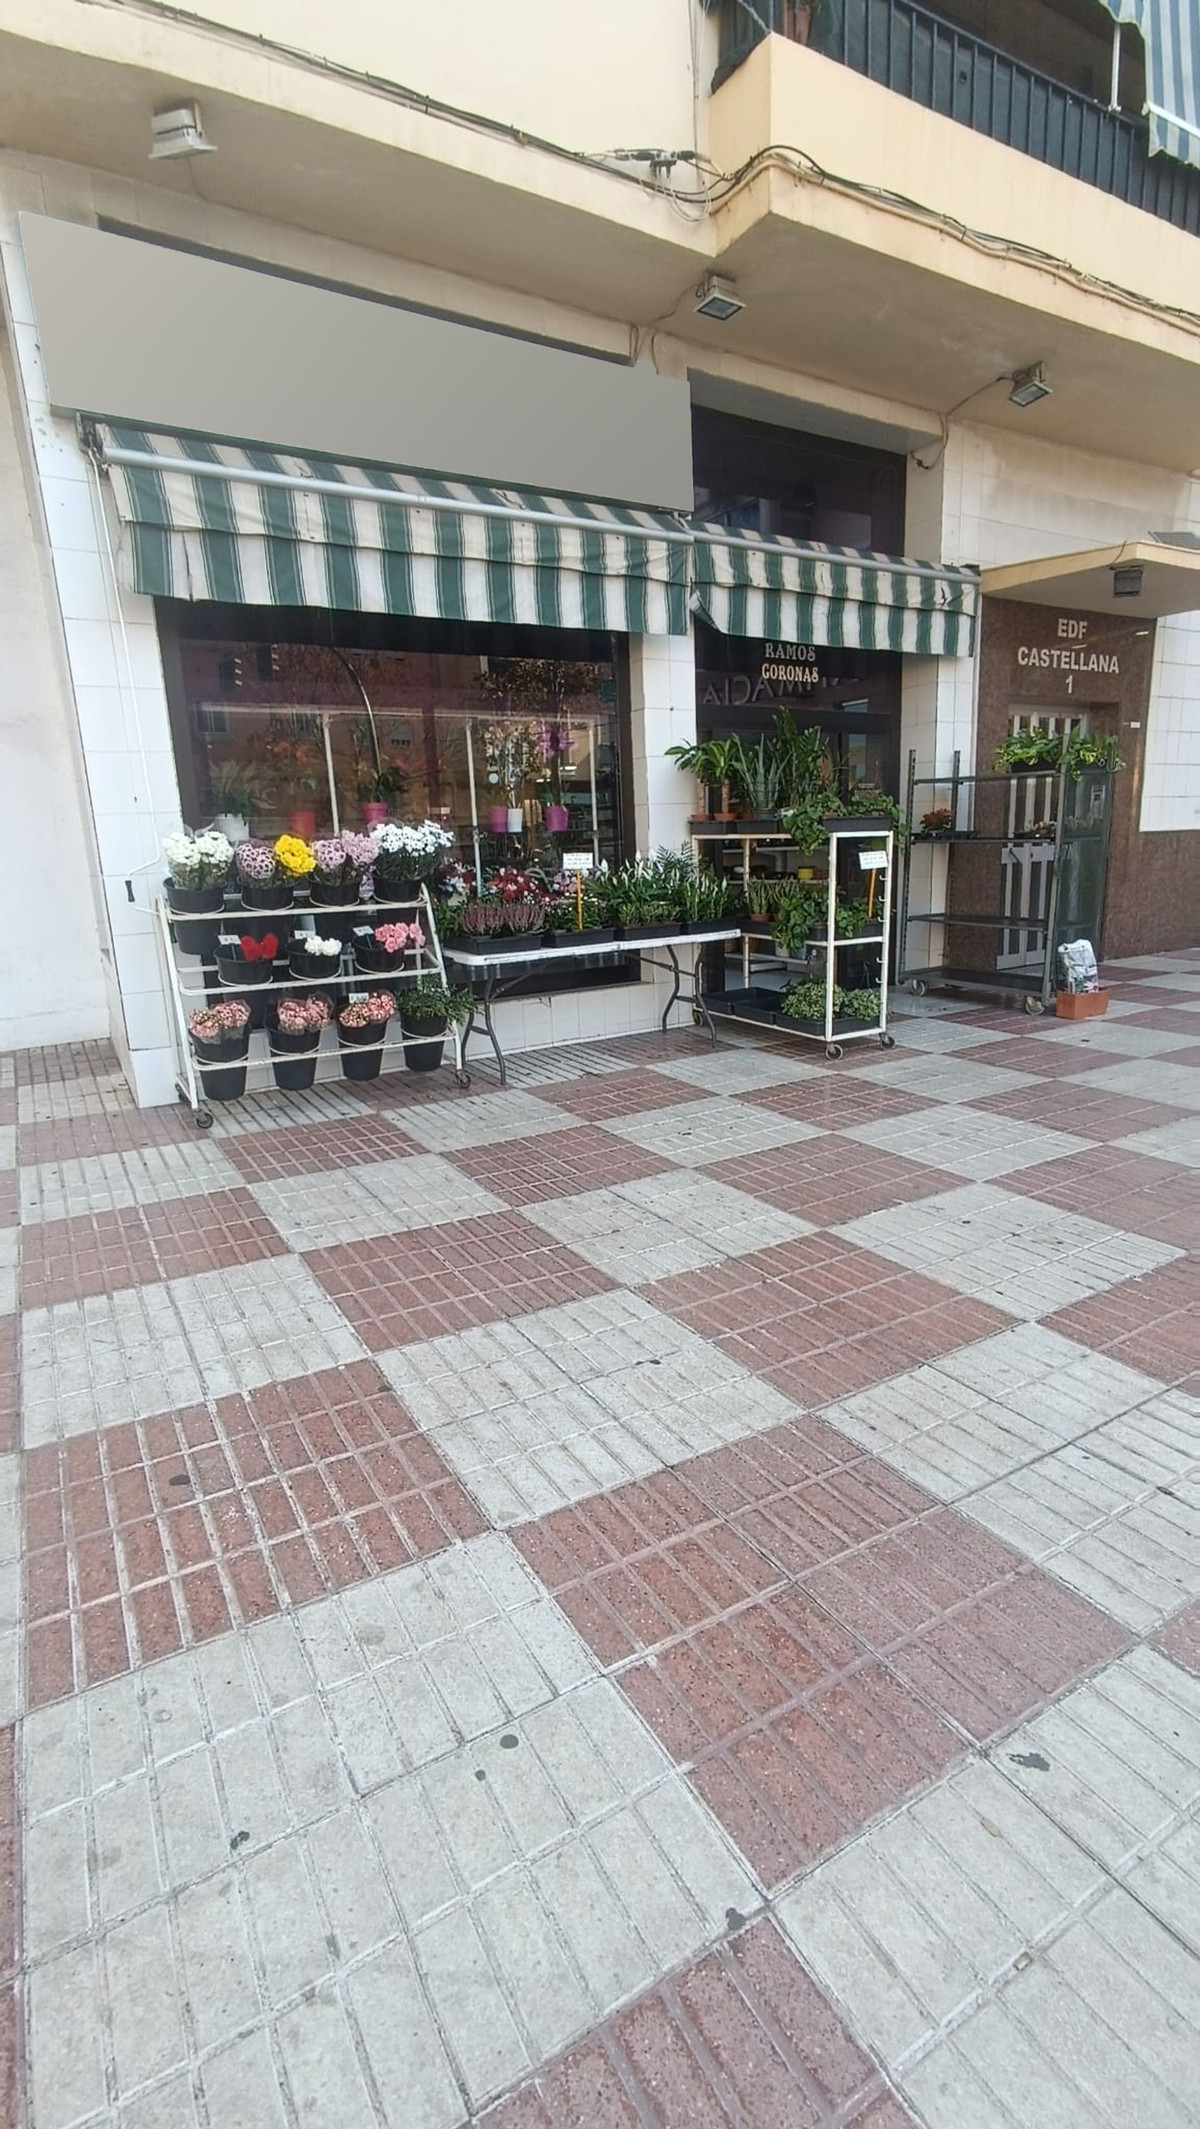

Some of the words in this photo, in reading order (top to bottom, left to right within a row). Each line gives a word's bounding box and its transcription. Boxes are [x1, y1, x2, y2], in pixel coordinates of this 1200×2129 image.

[1057, 618, 1088, 639] EDF
[765, 642, 816, 662] RAMOS
[1017, 646, 1119, 673] CASTELLANA
[761, 663, 819, 683] CORONAS
[1065, 675, 1073, 694] 1
